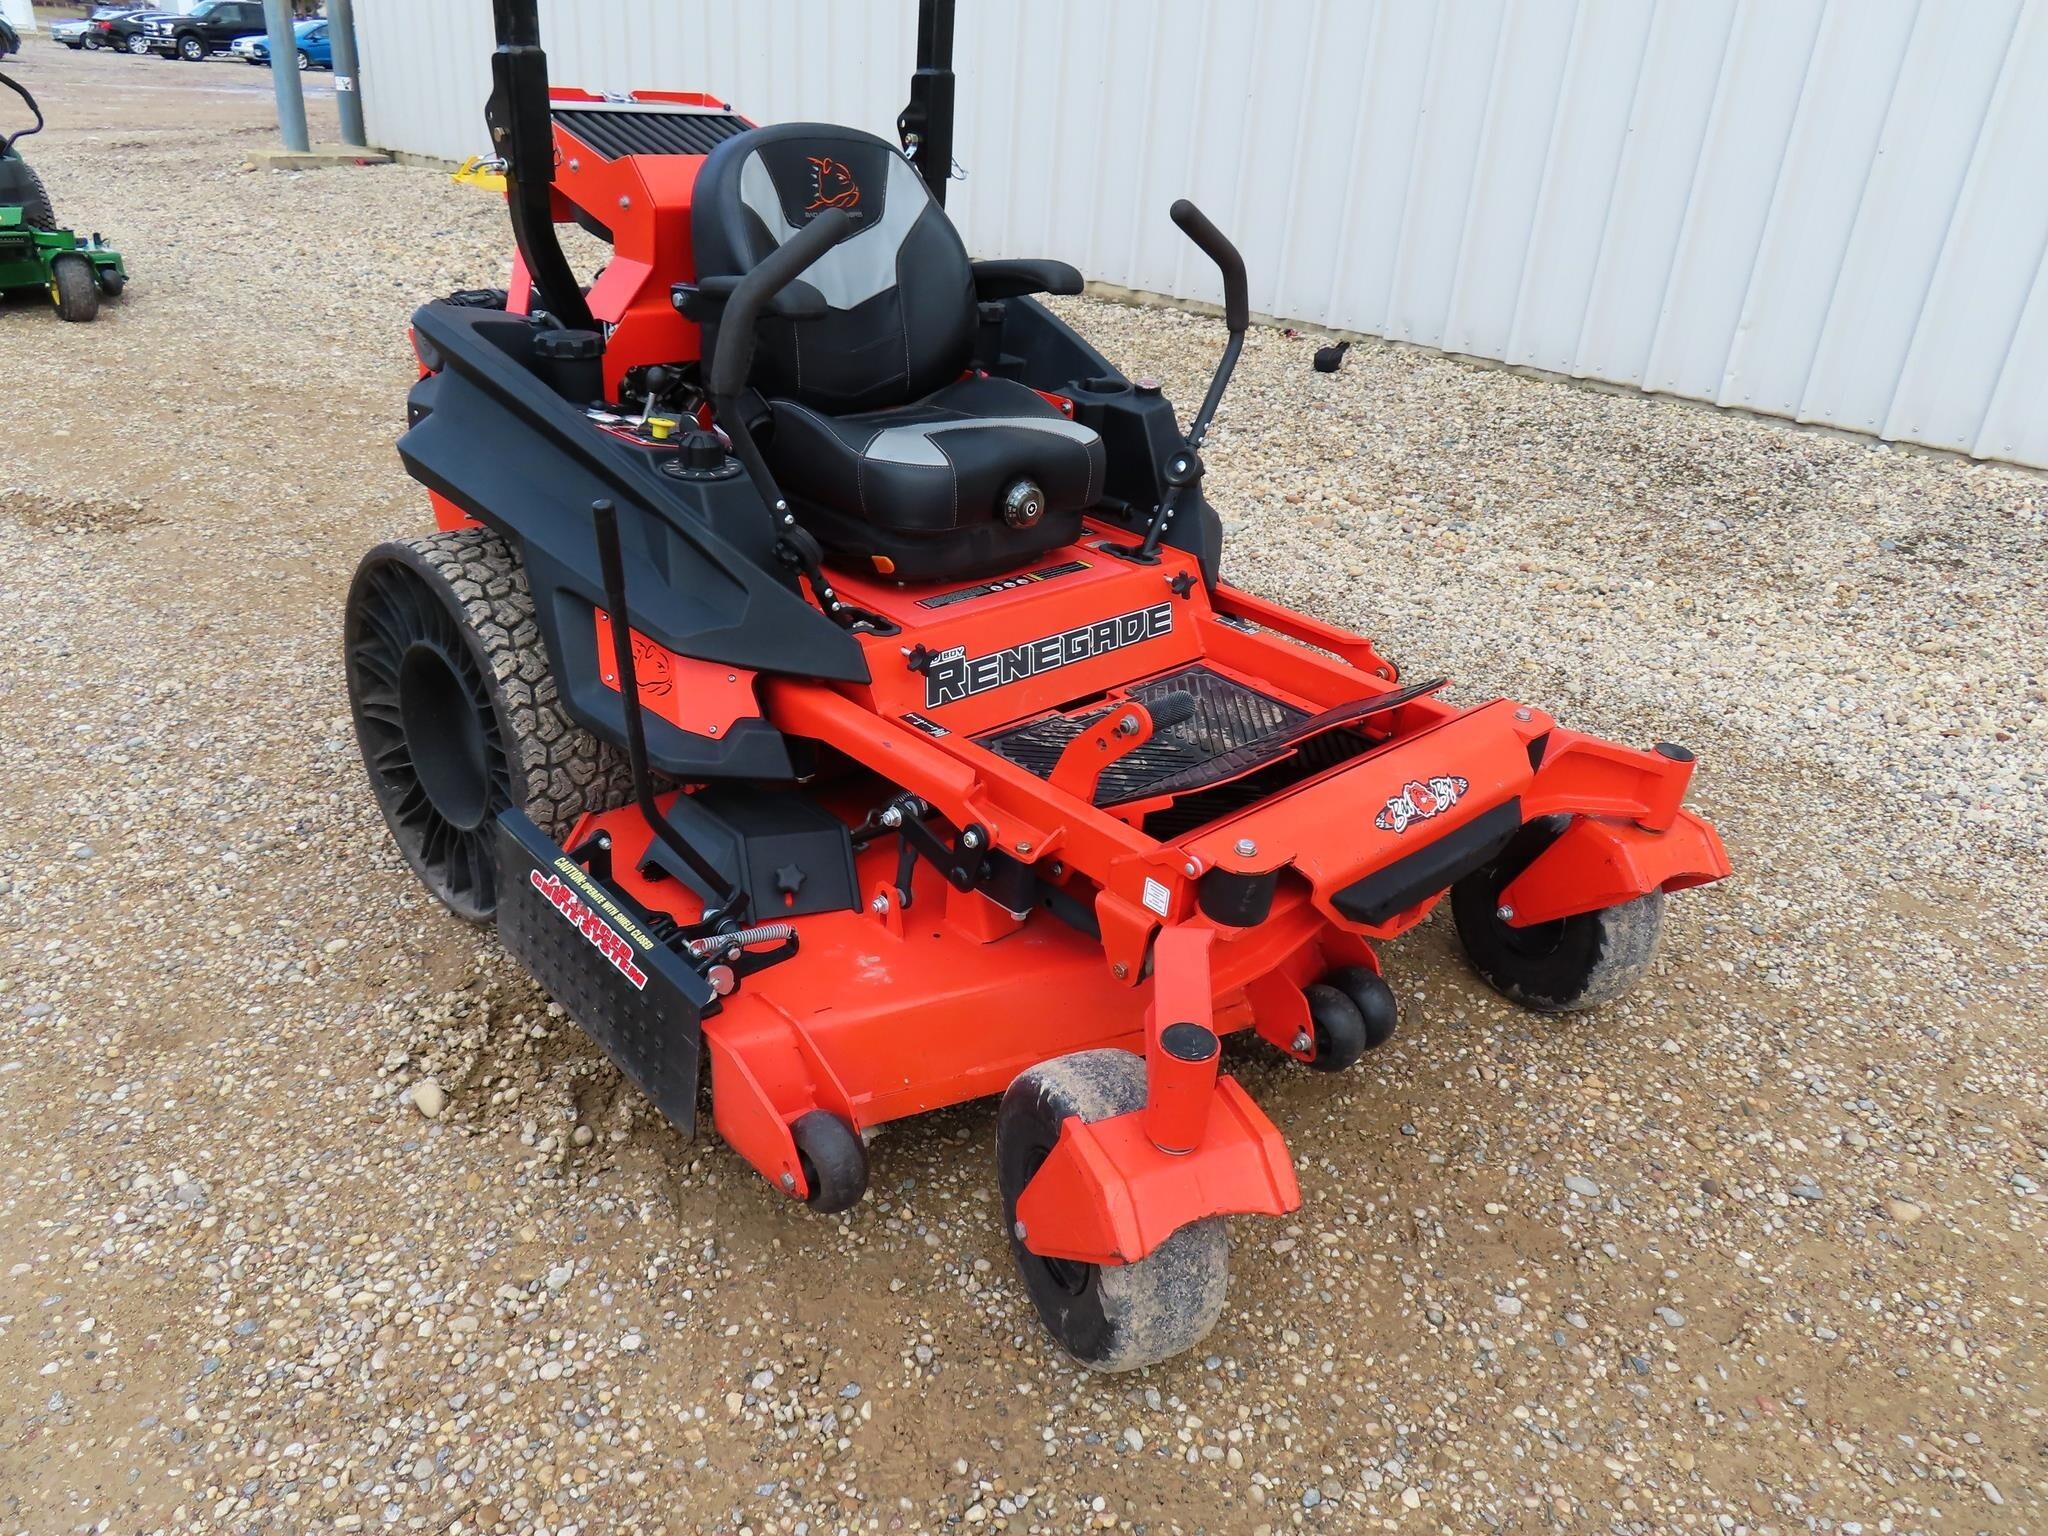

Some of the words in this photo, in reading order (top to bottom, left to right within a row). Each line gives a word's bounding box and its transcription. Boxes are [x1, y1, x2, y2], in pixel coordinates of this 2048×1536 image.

[926, 602, 1172, 709] RENEGADE
[530, 870, 581, 925] CHUTE
[578, 919, 648, 990] SYSTEM
[553, 856, 587, 886] CAUTION:
[581, 881, 606, 904] OPERATE
[600, 899, 618, 917] WITH
[613, 912, 636, 932] SHIELD
[630, 928, 655, 951] CLOSED
